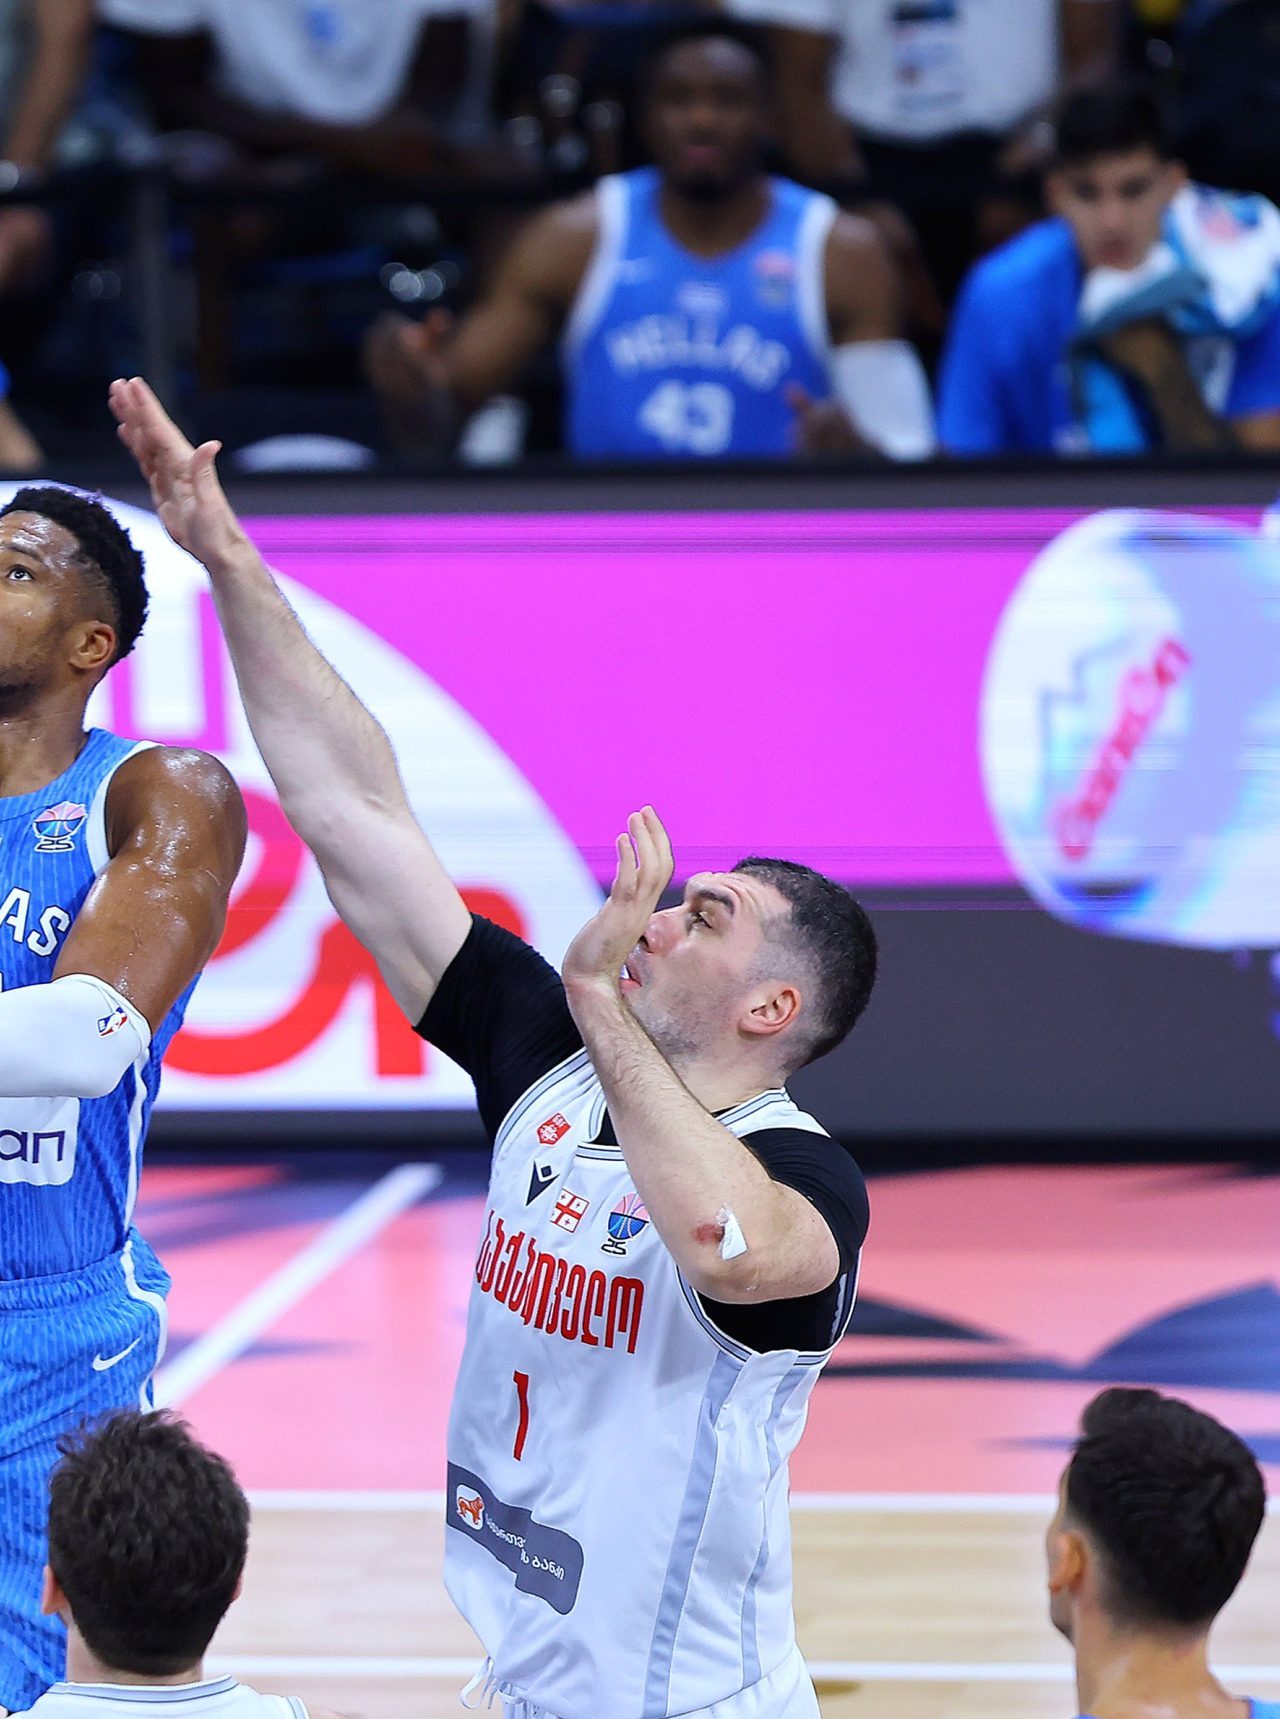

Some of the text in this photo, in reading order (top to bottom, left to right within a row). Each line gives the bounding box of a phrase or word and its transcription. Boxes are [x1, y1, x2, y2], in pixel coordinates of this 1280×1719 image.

[607, 317, 791, 389] HELLAS
[641, 379, 735, 455] 43
[476, 1209, 645, 1354] საქათველო
[512, 1370, 531, 1462] 1
